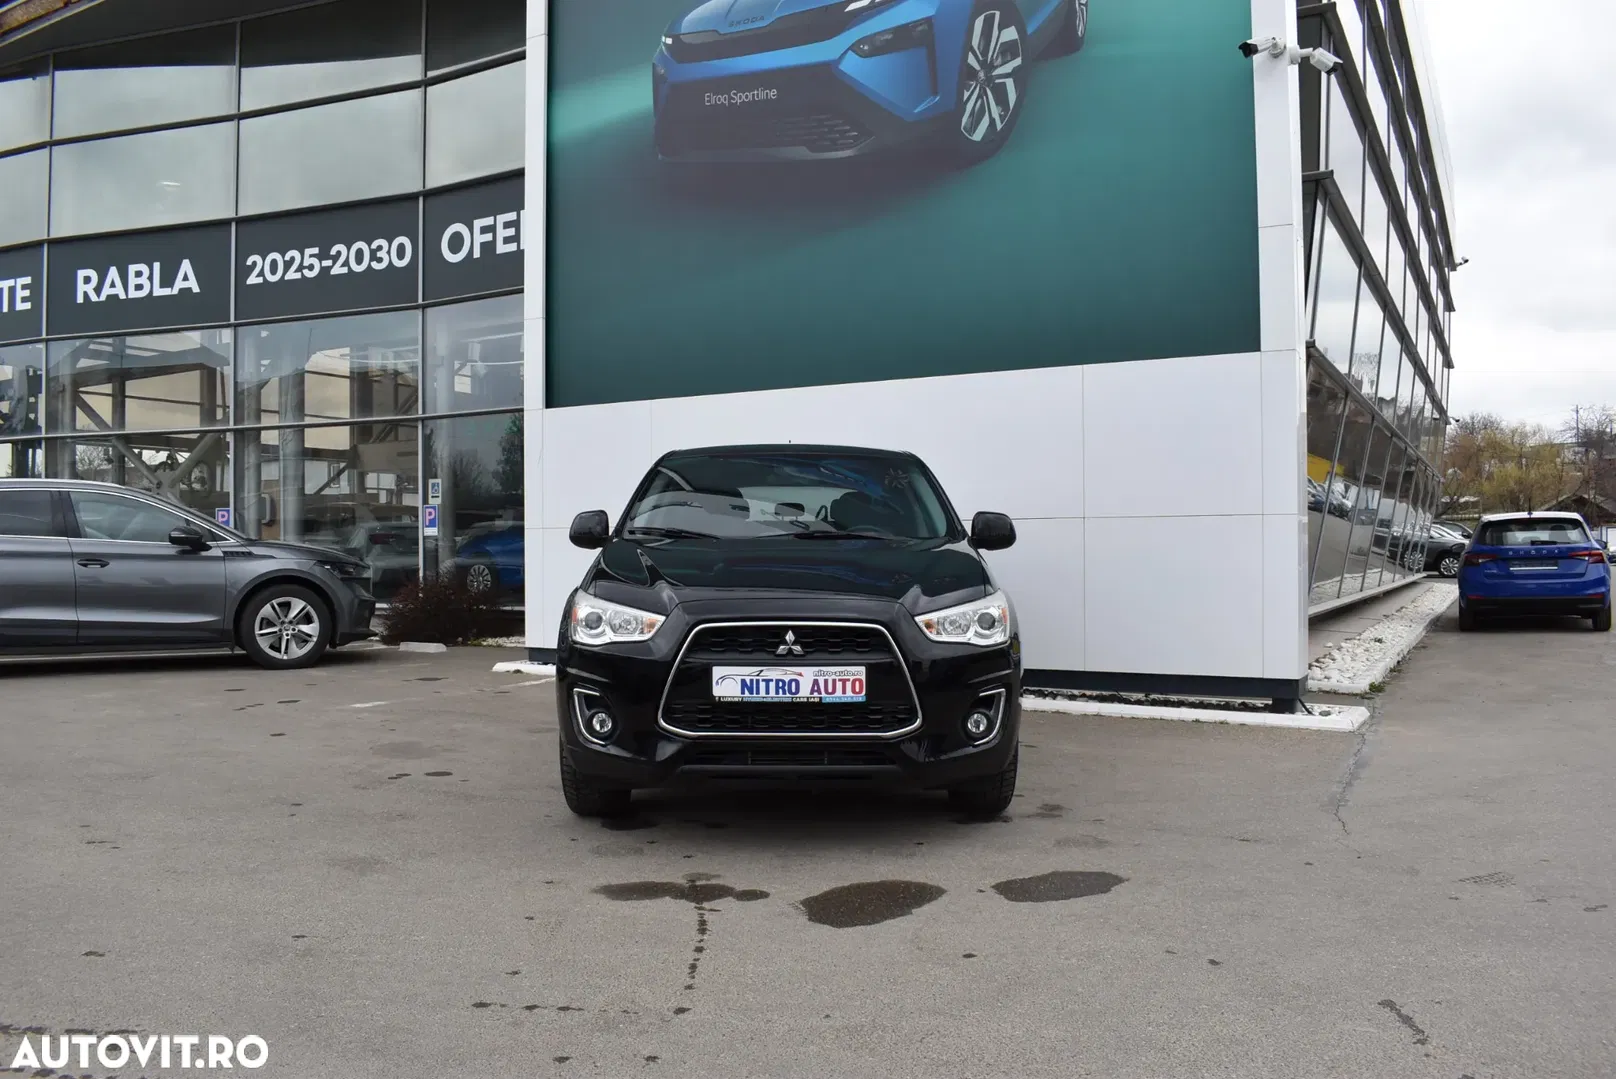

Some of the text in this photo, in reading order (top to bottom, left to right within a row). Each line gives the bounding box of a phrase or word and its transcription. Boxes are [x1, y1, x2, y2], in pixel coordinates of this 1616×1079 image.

[704, 87, 778, 107] Elroq Sportline
[76, 258, 201, 304] RABLA
[245, 236, 413, 284] 2025-2030
[425, 508, 436, 526] P
[812, 669, 864, 677] nitro-auto.ro
[740, 678, 864, 696] NITRO AUTO
